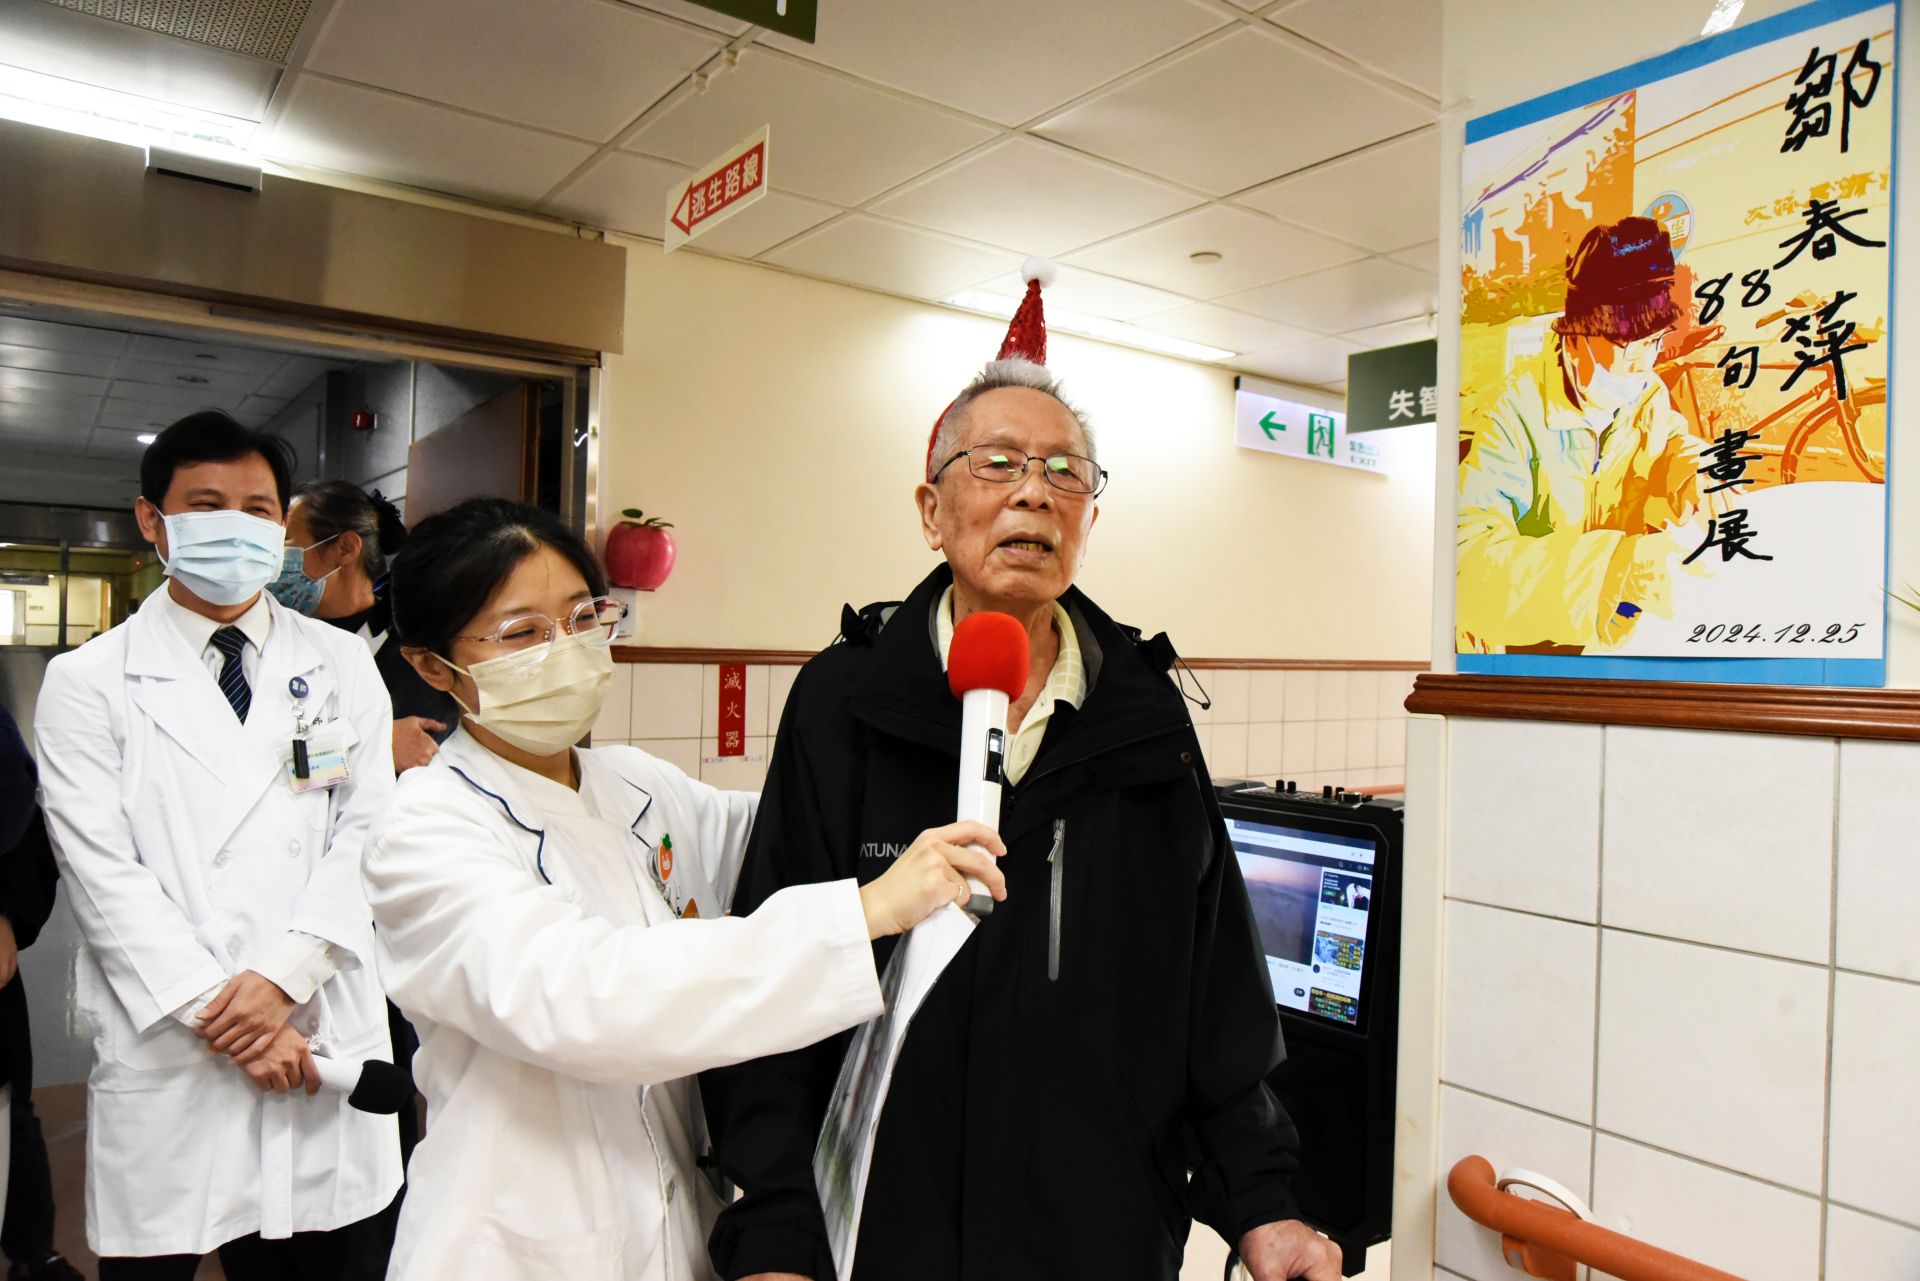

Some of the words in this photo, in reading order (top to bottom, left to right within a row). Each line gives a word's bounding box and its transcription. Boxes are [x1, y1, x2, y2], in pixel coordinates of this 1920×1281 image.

[691, 152, 759, 221] 逃生路線
[1685, 622, 1866, 644] 2024.12.25
[724, 671, 742, 748] 滅火器
